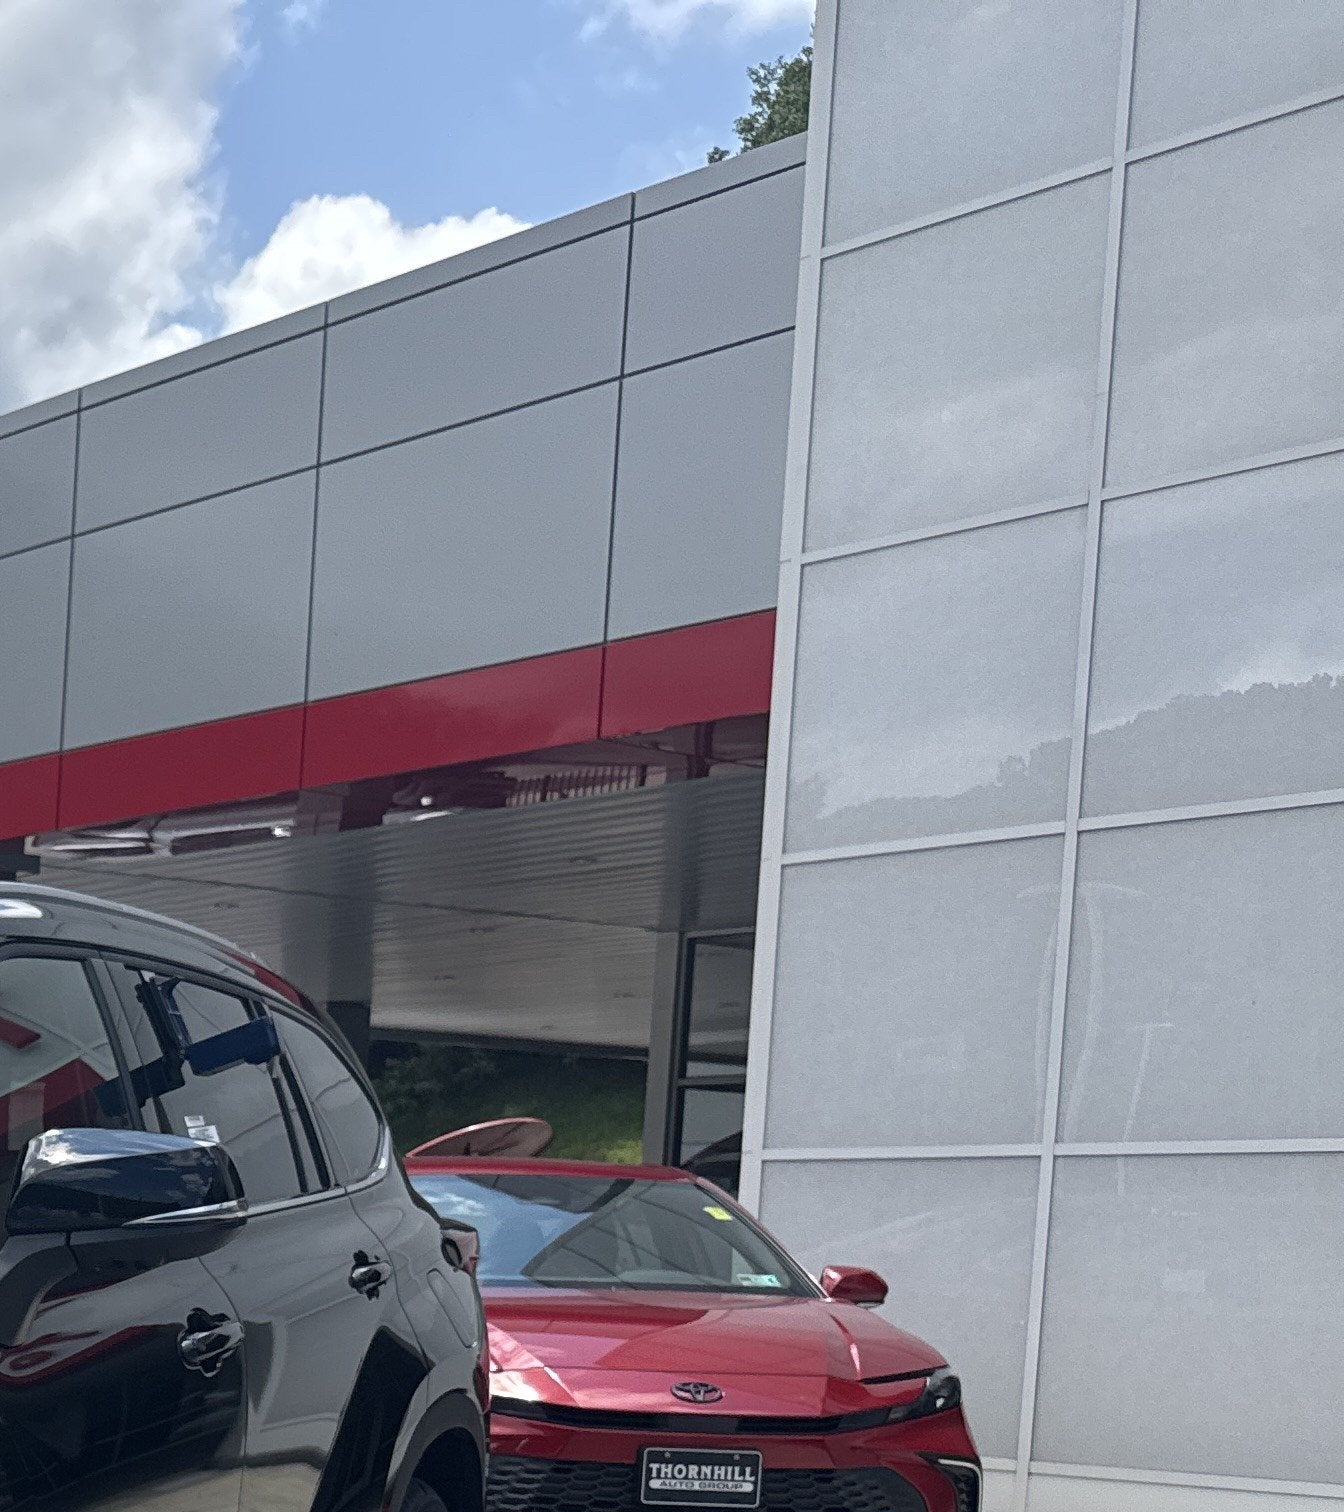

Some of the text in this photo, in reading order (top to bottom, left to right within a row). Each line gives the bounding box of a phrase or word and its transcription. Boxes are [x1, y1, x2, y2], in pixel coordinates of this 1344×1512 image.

[649, 1463, 755, 1481] THORNHILL
[659, 1481, 743, 1490] AUTO GROUP
